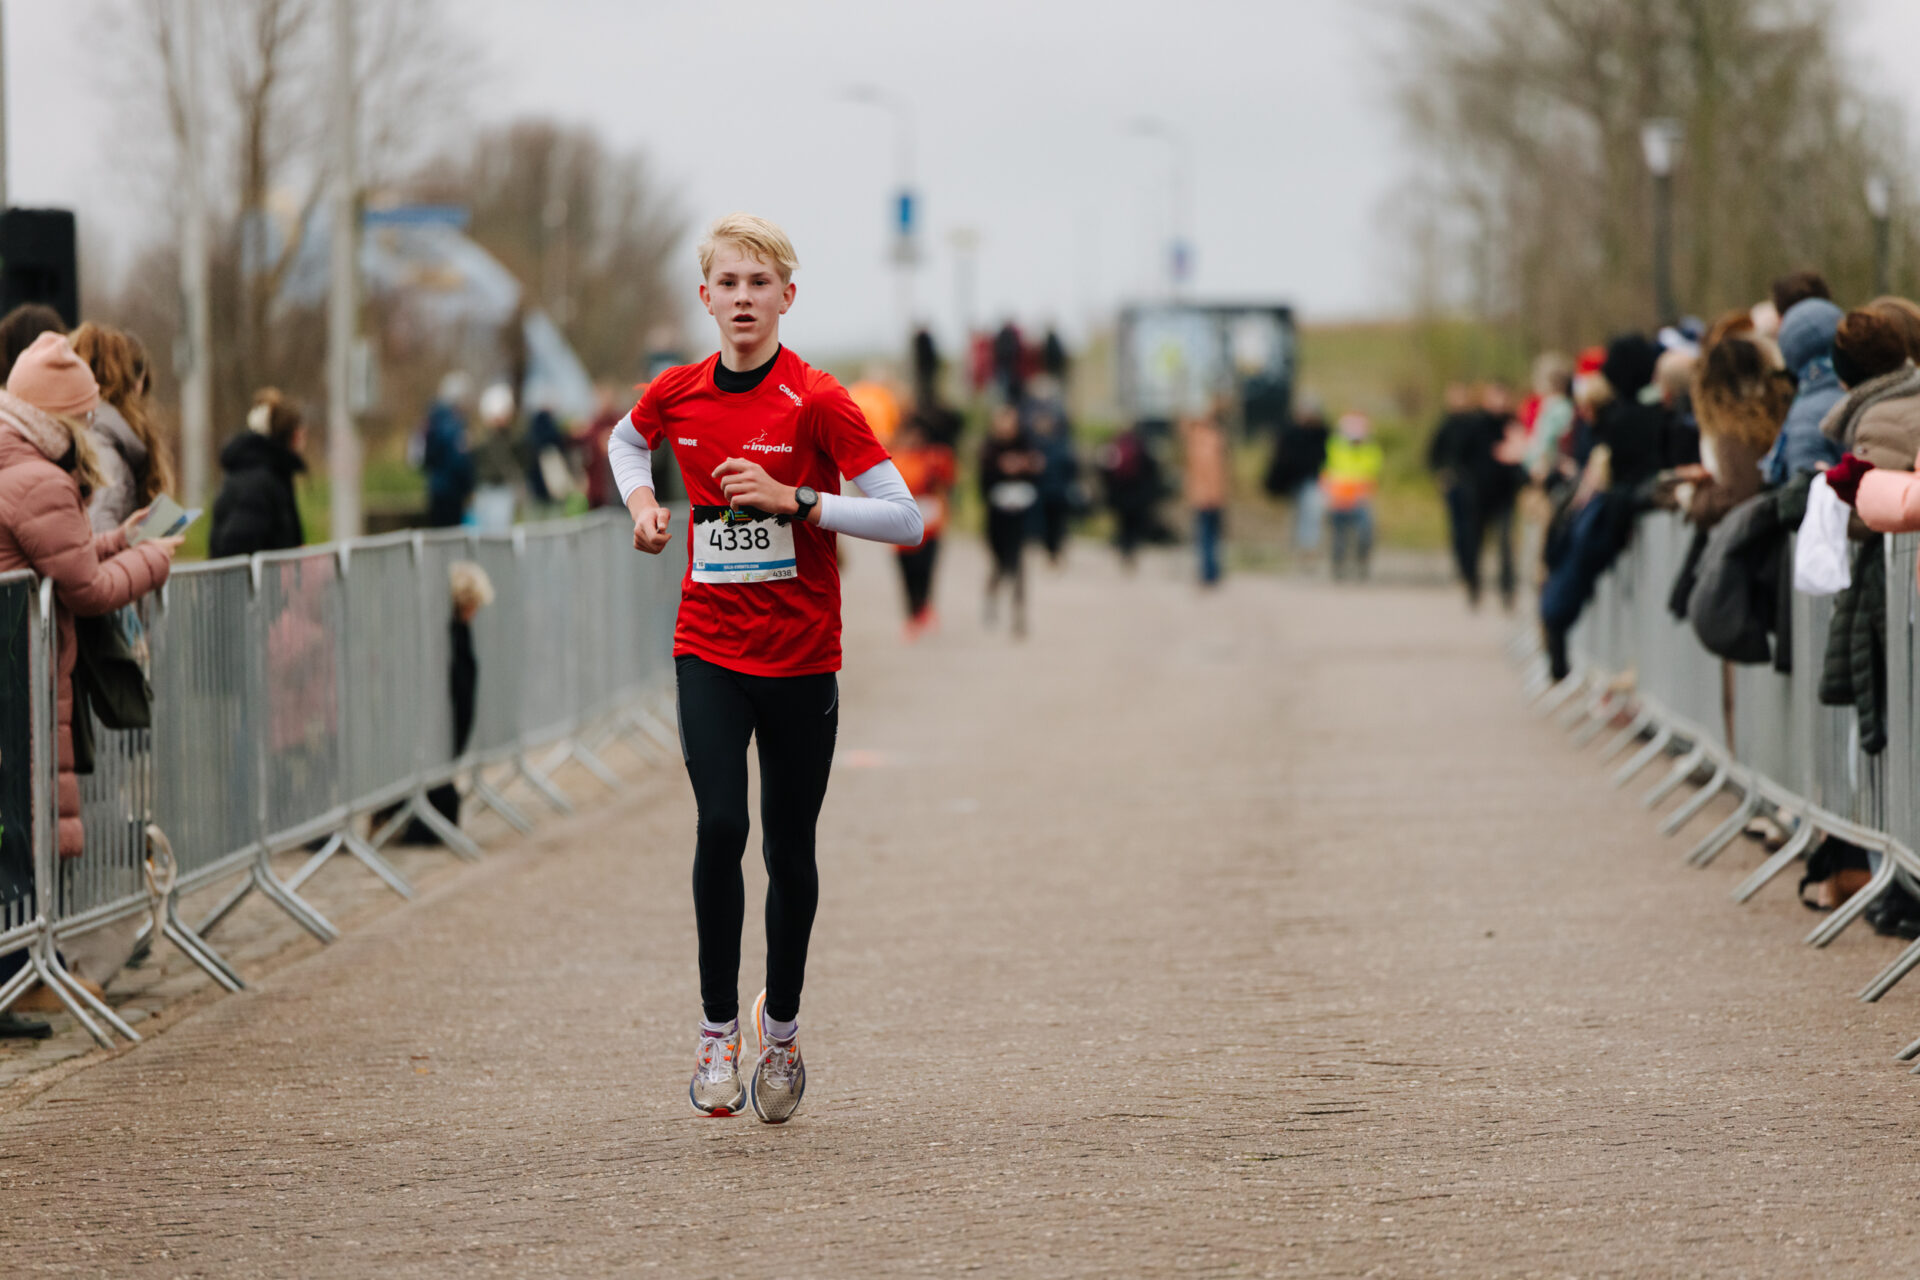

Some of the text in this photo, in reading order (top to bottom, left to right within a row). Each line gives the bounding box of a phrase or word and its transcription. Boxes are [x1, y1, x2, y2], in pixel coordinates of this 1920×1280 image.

[779, 384, 801, 403] CRAFT
[751, 442, 793, 454] impala
[710, 527, 770, 551] 4338
[773, 570, 792, 578] 4338
